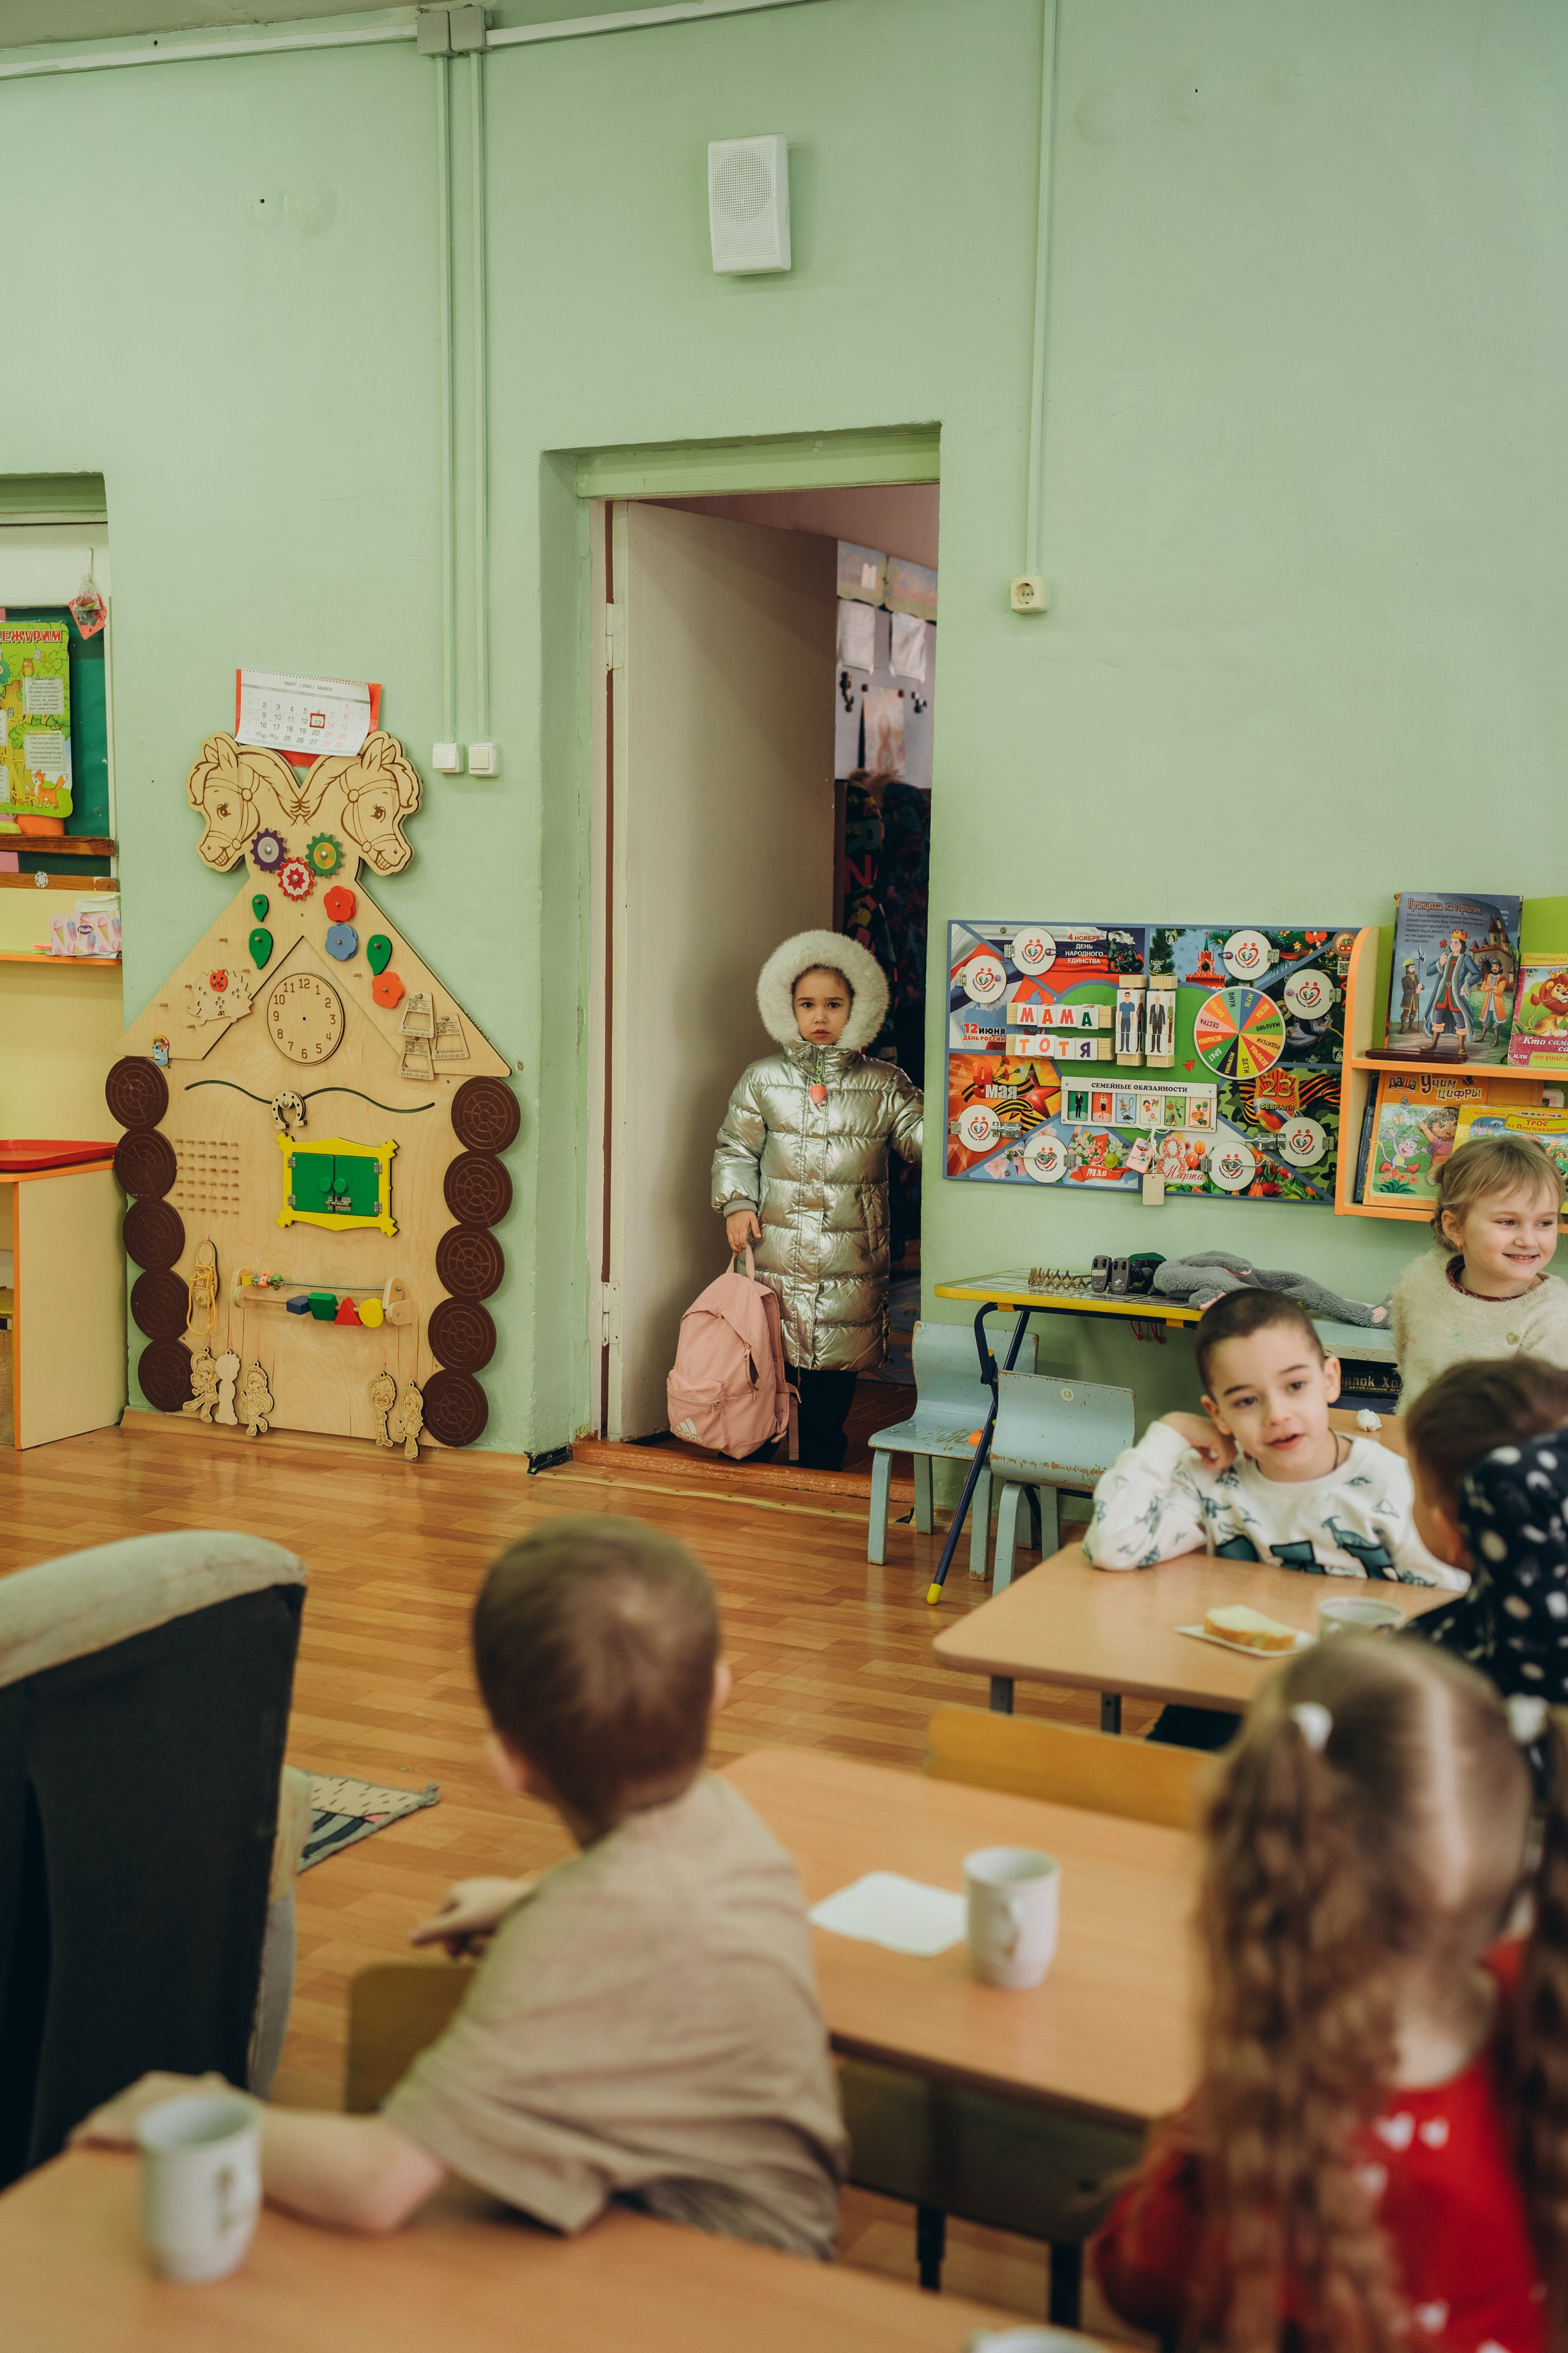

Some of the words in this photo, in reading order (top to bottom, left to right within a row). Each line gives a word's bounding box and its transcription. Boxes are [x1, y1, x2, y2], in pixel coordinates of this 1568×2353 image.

[0, 630, 62, 643] ЕЖУРИМ
[1408, 898, 1443, 912] Принцесса
[1455, 903, 1482, 915] горошине
[284, 983, 295, 992] 11
[299, 978, 310, 989] 12
[315, 984, 320, 995] 1
[274, 994, 285, 1005] 10
[325, 997, 331, 1008] 2
[1245, 993, 1254, 1008] МУЖ
[1210, 1000, 1225, 1018] ВНУЧКА
[1255, 1003, 1270, 1018] ЖЕНА
[274, 1011, 279, 1021] 9
[330, 1014, 336, 1024] 3
[1020, 1007, 1093, 1027] МАМА
[963, 1024, 978, 1033] 12
[1200, 1018, 1219, 1029] СЕСТРА
[1256, 1021, 1280, 1032] МАЛЬЧИК
[277, 1029, 283, 1039] 8
[326, 1032, 331, 1041] 4
[1198, 1035, 1222, 1044] ЖЕНЩИНА
[288, 1041, 293, 1051] 7
[1257, 1038, 1281, 1049] РОДИТЕЛИ
[1523, 1037, 1545, 1045] Кто
[316, 1043, 322, 1054] 5
[1019, 1038, 1090, 1058] ТОТЯ
[301, 1049, 307, 1059] 6
[1208, 1048, 1222, 1062] БРАТ
[1250, 1045, 1268, 1067] ДЕВОЧКА
[1224, 1052, 1235, 1074] МУЖЧИНА
[973, 1062, 993, 1098] 9
[1134, 1083, 1188, 1093] ОБЯЗАННОСТИ
[1262, 1078, 1292, 1097] 23
[1163, 1164, 1204, 1183] Марта
[674, 1429, 703, 1443] adidas
